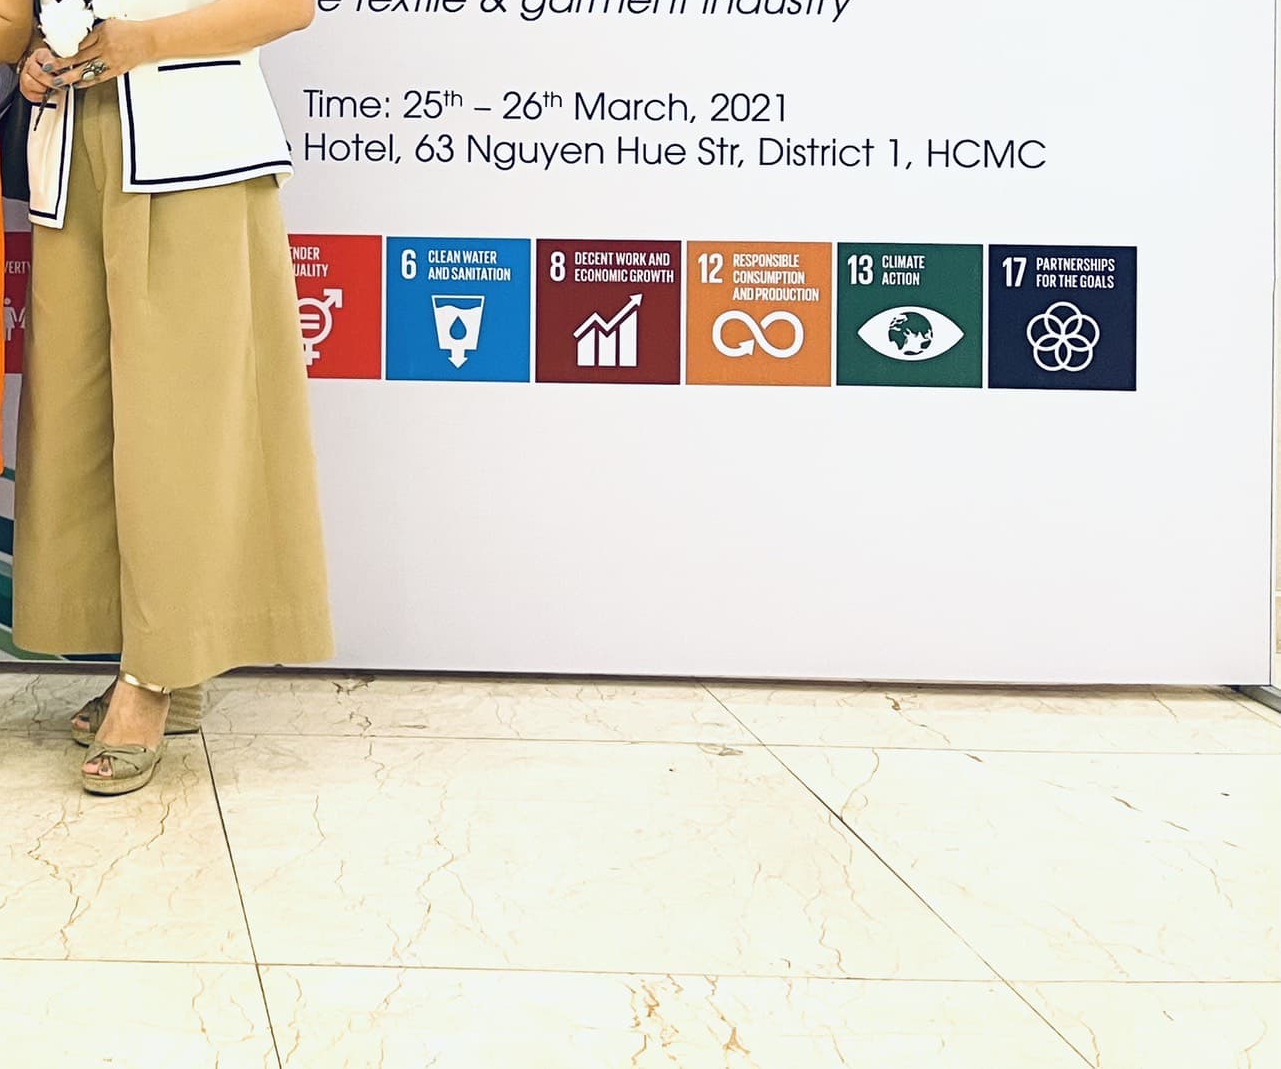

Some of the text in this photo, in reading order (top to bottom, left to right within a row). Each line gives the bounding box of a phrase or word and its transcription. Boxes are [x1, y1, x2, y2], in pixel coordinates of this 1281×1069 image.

[302, 89, 390, 119] Time:
[403, 89, 463, 119] 25th
[502, 90, 563, 120] 26th
[575, 91, 696, 124] March,
[710, 92, 785, 122] 2021
[304, 132, 1046, 171] Hotel, 63 Nguyen Hue Str, District 1, HCMC
[401, 249, 417, 280] 6
[428, 249, 497, 265] CLEAN WATER
[574, 251, 670, 267] DECENT WORK AND
[732, 253, 800, 268] RESPONSIBLE
[881, 254, 926, 269] CLIMATE
[1036, 257, 1116, 272] PARTNERSHIPS
[427, 266, 511, 282] AND SANITATION
[549, 251, 566, 282] 8
[697, 252, 724, 284] 12
[847, 254, 874, 285] 13
[1002, 256, 1027, 288] 17
[574, 268, 674, 283] ECONOMIC GROWTH
[732, 270, 806, 285] CONSUMPTION
[881, 271, 920, 286] ACTION
[1036, 273, 1115, 289] FOR THE GOALS
[731, 287, 820, 302] AND PRODUCTION
